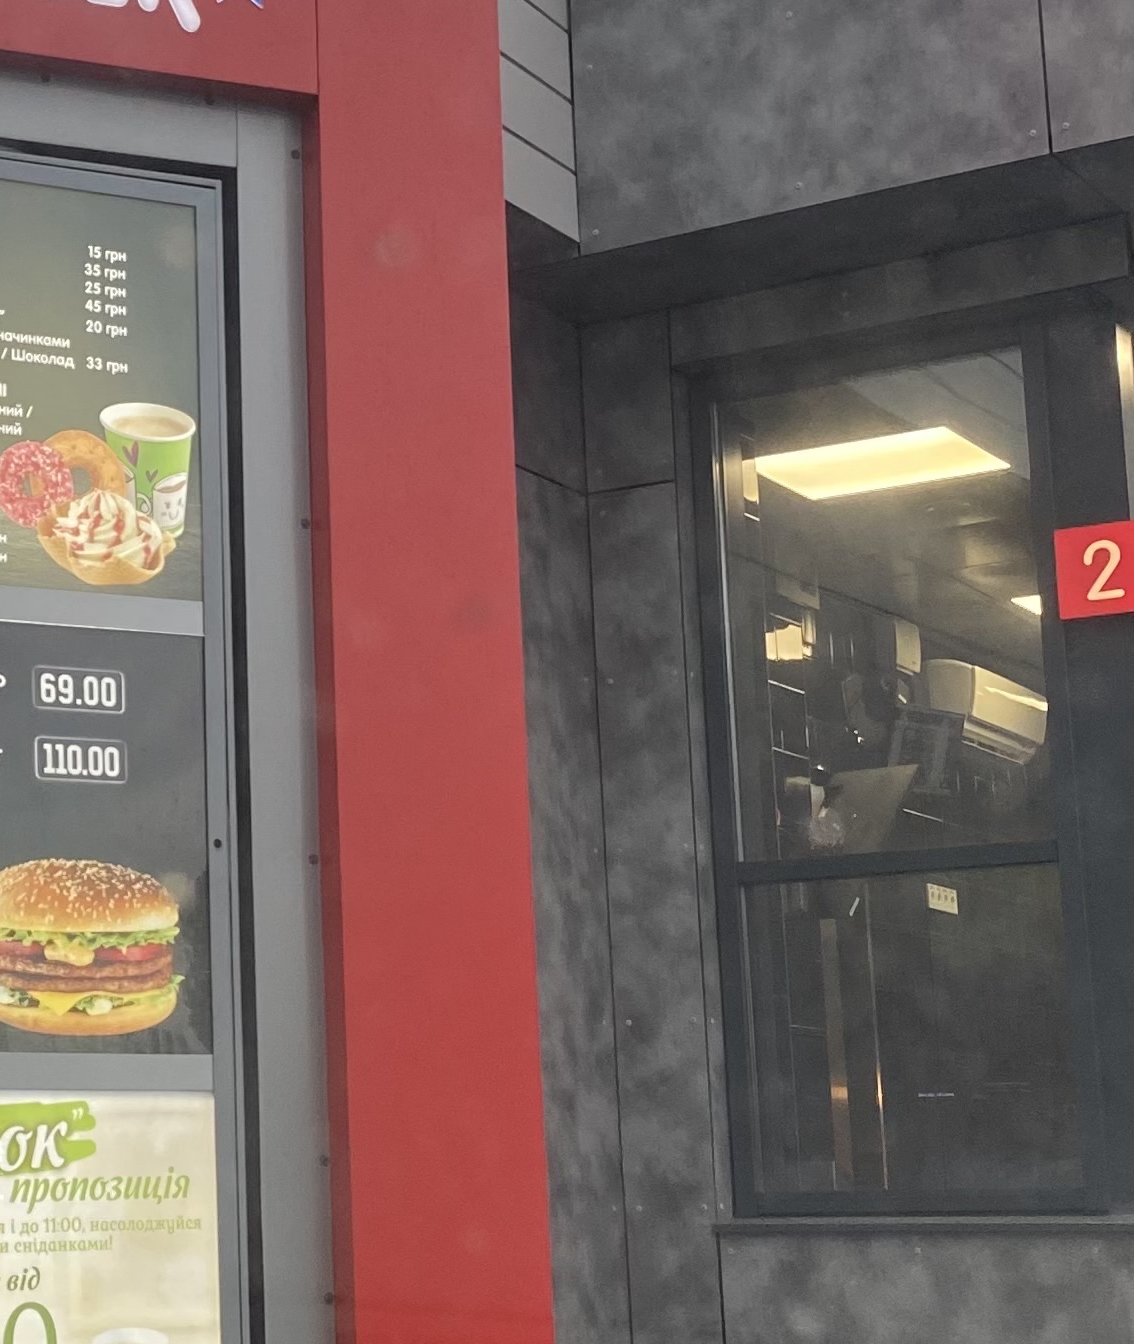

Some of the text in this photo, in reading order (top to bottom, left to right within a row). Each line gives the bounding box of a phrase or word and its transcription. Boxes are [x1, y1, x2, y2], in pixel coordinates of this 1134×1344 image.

[88, 246, 101, 258] 15
[105, 250, 127, 263] грн
[84, 263, 101, 276] 35
[104, 268, 126, 281] грн
[85, 281, 101, 294] 25
[105, 286, 126, 299] грн
[85, 300, 101, 312] 45
[105, 304, 126, 317] грн
[86, 320, 102, 333] 20
[106, 325, 127, 338] грн
[11, 348, 75, 369] Шоколад
[86, 356, 102, 370] 33
[106, 361, 128, 374] грн
[1082, 539, 1126, 601] 2
[39, 672, 118, 707] 69.00
[42, 743, 120, 777] 110.00
[10, 1166, 190, 1214] пропозиція
[19, 1222, 39, 1235] до
[90, 1216, 202, 1235] насолоджуйся
[14, 1235, 113, 1256] сніданками!
[7, 1266, 41, 1292] від
